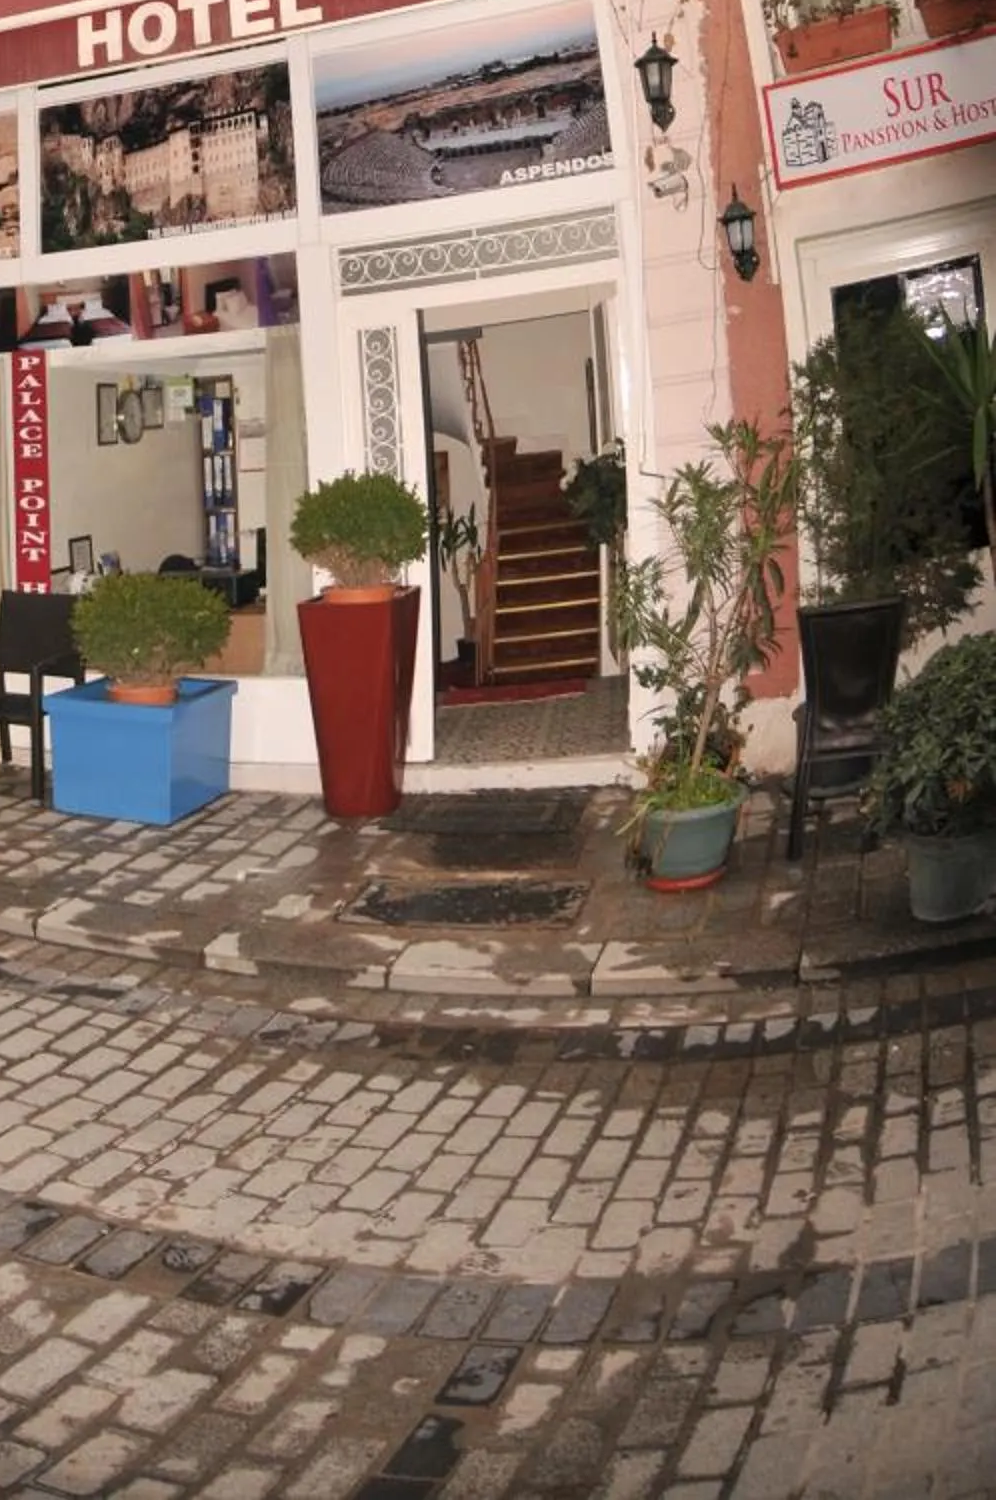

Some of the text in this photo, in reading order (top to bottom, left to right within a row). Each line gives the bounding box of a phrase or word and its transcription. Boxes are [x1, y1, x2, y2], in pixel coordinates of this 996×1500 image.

[883, 73, 952, 117] SUR
[932, 109, 949, 131] &
[500, 151, 615, 185] ASPENDOS
[18, 356, 43, 459] PALACE
[19, 478, 47, 562] POINT
